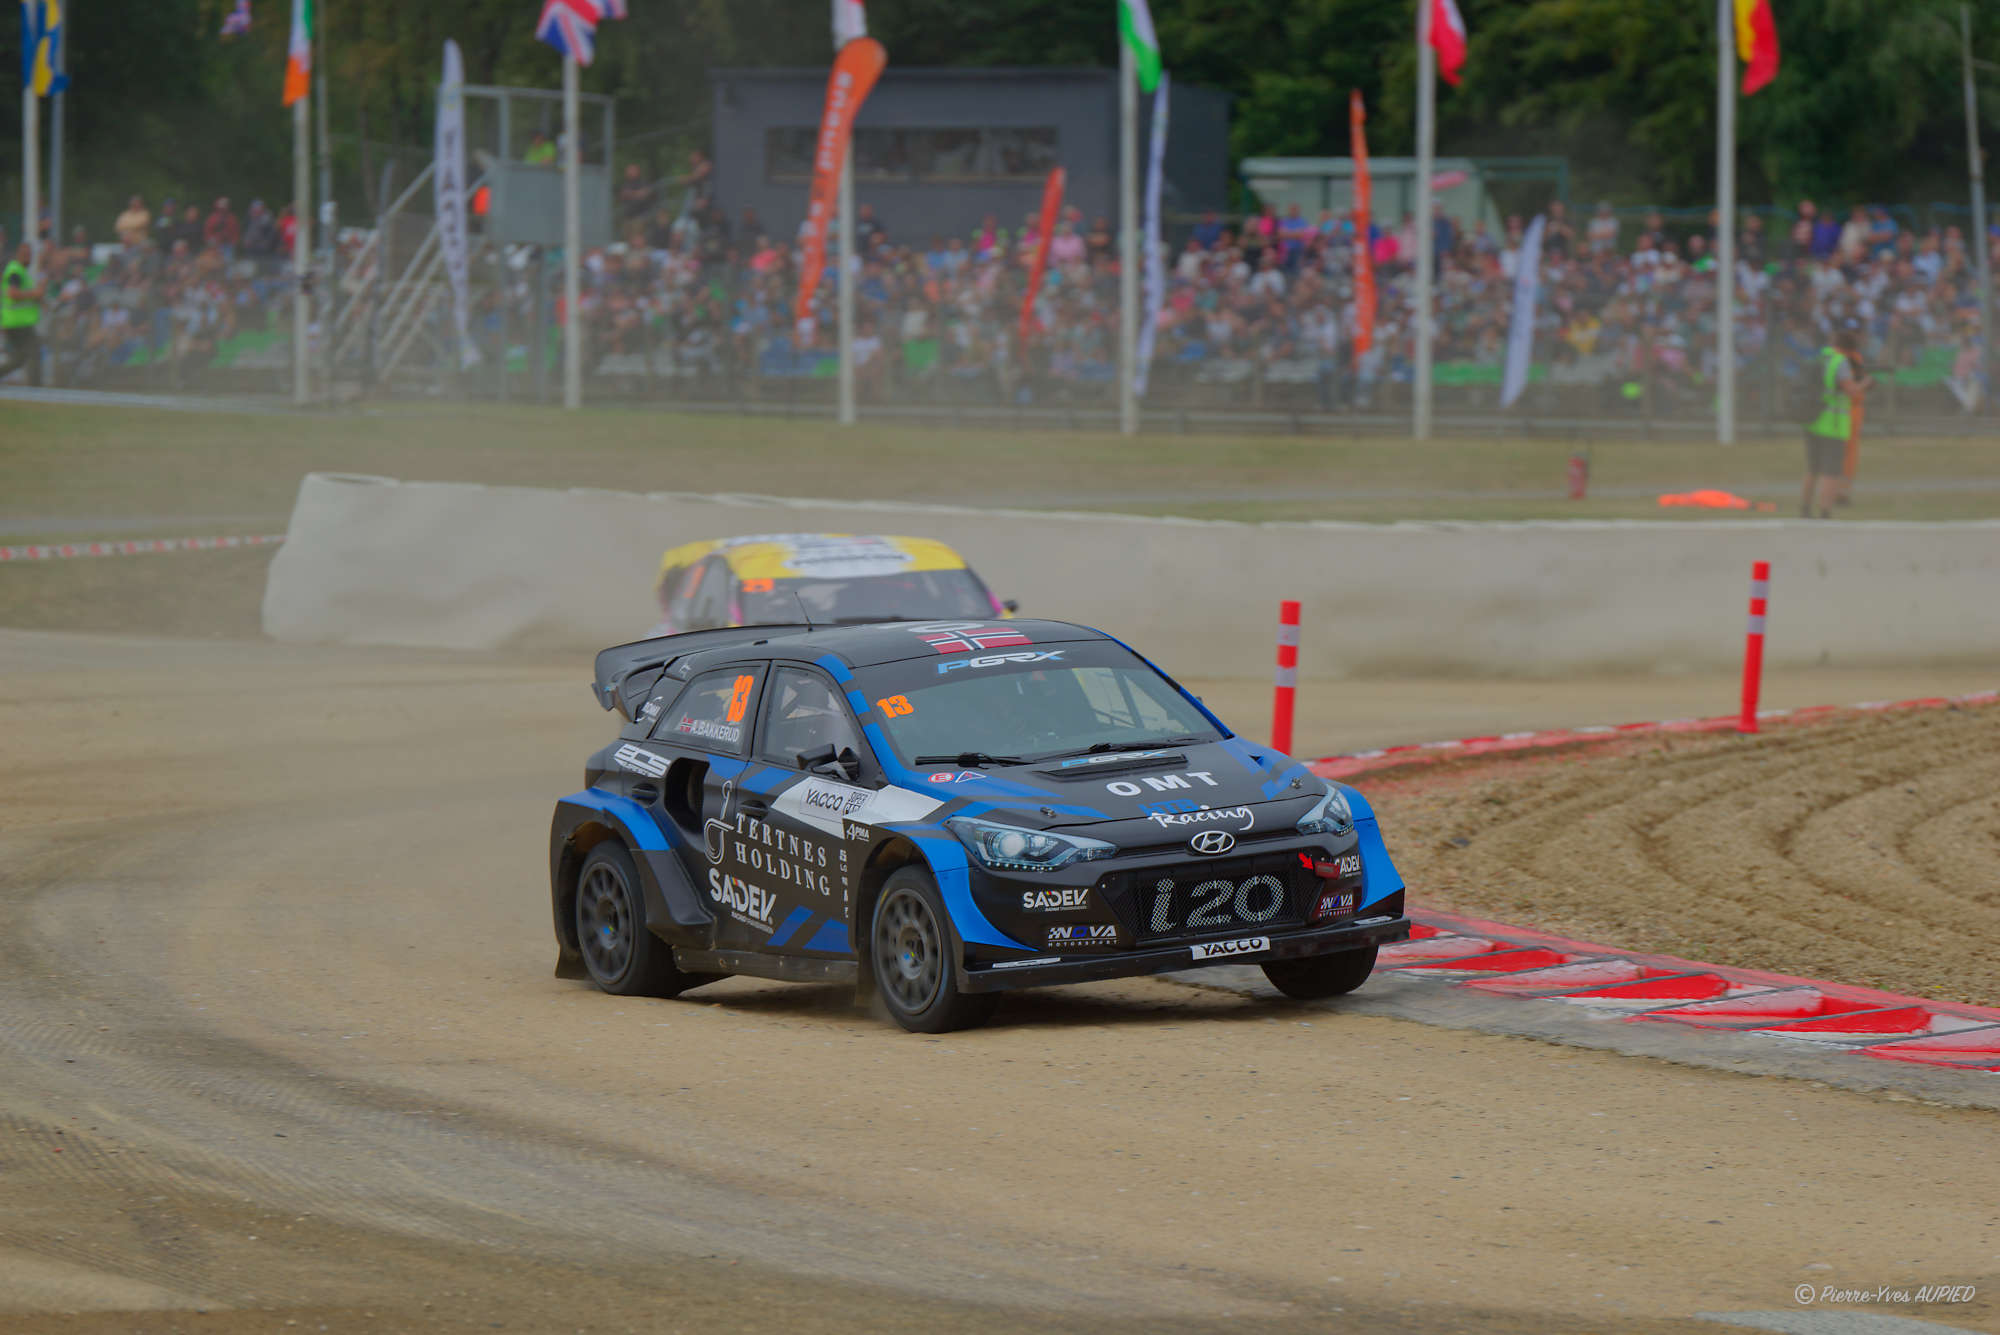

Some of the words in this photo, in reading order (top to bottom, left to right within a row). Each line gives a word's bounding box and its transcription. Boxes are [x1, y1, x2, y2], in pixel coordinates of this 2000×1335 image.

[938, 650, 1066, 675] PGRX
[726, 674, 754, 722] 13
[876, 694, 915, 719] 13
[1061, 750, 1168, 768] PGRX
[1106, 771, 1219, 797] OMT
[806, 788, 844, 812] YACCO
[1147, 805, 1255, 832] Racing
[735, 812, 827, 868] TERTNES
[734, 841, 831, 897] HOLDING
[708, 867, 777, 924] SADEV
[1023, 888, 1089, 909] SADEV
[1150, 874, 1285, 933] i20
[1059, 925, 1118, 939] NOVA
[1200, 937, 1263, 956] YACCO
